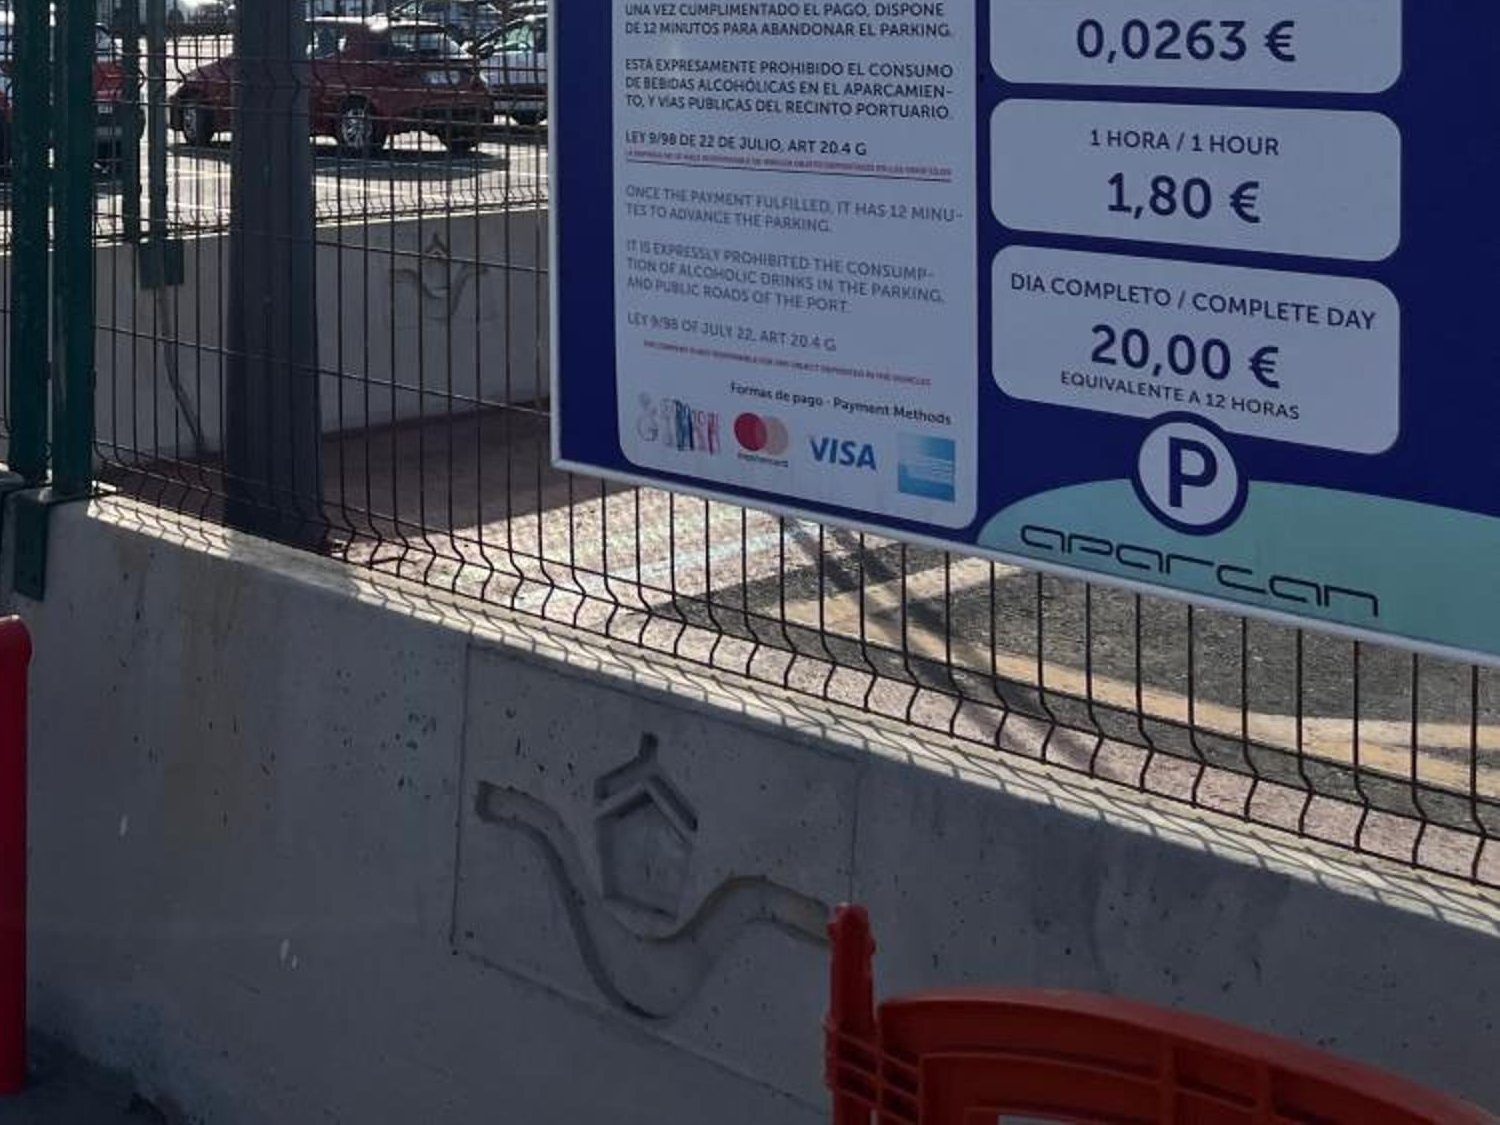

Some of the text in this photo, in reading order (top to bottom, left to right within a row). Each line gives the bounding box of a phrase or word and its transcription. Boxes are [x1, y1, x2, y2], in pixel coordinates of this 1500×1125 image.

[625, 4, 650, 16] UNA
[653, 4, 676, 16] VEZ
[679, 3, 800, 17] CUMPLIMENTADO
[804, 3, 819, 16] EL
[875, 3, 944, 17] DISPONE
[625, 22, 641, 35] DE
[643, 23, 657, 34] 12
[660, 22, 719, 36] MINUTOS
[723, 23, 758, 36] PARA
[761, 23, 855, 36] ABANDONAR
[858, 24, 875, 37] EL
[1077, 19, 1296, 64] 0,0263 €
[655, 59, 756, 74] EXPRESAMENTE
[760, 61, 844, 75] PROHIBIDO
[848, 63, 865, 76] EL
[869, 64, 953, 78] CONSUMO
[625, 77, 640, 89] DE
[643, 78, 695, 91] BEBIDAS
[799, 81, 818, 95] EN
[823, 82, 839, 95] EL
[626, 95, 644, 108] TO,
[647, 96, 656, 107] Y
[756, 100, 782, 113] DEL
[785, 101, 852, 115] RECINTO
[625, 131, 646, 145] LEY
[679, 134, 696, 147] DE
[700, 135, 715, 148] 22
[718, 136, 735, 150] DE
[787, 139, 815, 153] ART
[856, 143, 867, 155] G
[1091, 130, 1100, 145] 1
[1108, 131, 1170, 149] HORA
[1191, 135, 1202, 151] 1
[1209, 136, 1279, 155] HOUR
[1108, 173, 1260, 223] 1,80 €
[1011, 273, 1045, 292] DIA
[1050, 276, 1171, 307] COMPLETO
[1192, 292, 1319, 325] COMPLETE
[1327, 308, 1376, 330] DAY
[1091, 324, 1280, 388] 20,00 €
[731, 382, 951, 425] Formas de pago Payment Methods
[1060, 371, 1300, 421] EQUIVALENTE A 12 HORAS
[810, 437, 877, 470] VISA
[1169, 436, 1218, 508] P
